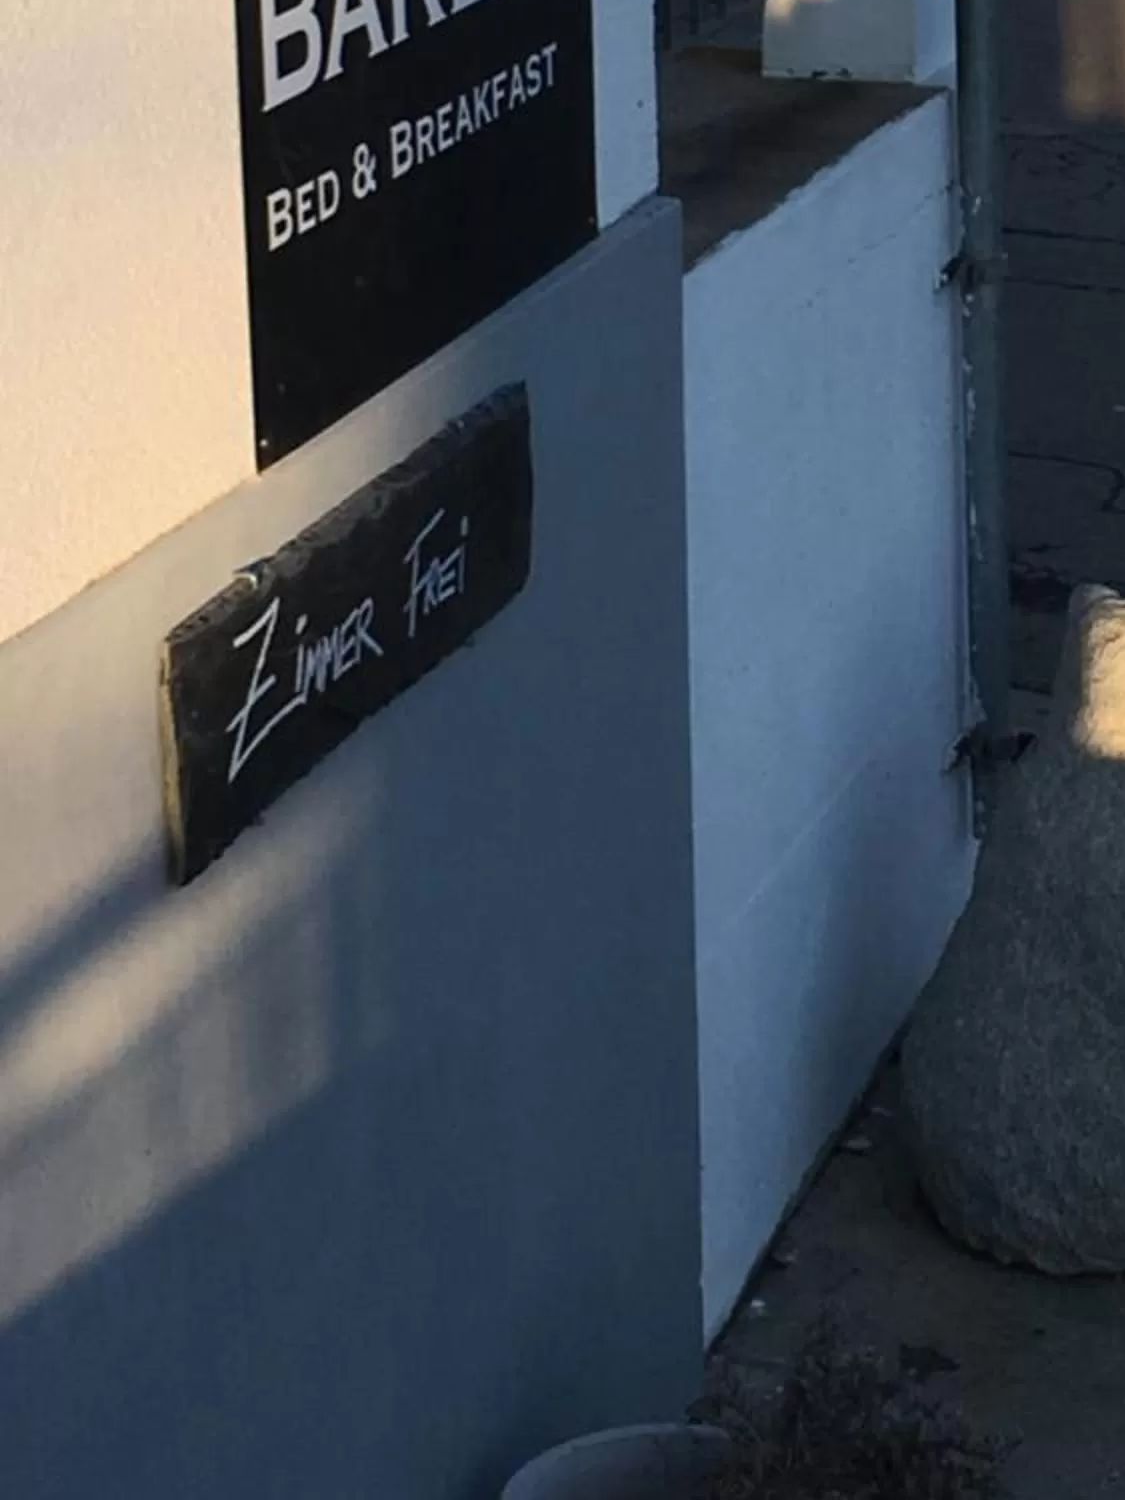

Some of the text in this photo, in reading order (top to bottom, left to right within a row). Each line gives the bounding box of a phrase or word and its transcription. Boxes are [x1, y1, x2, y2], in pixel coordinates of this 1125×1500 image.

[266, 43, 558, 252] BED & BREAKFAST
